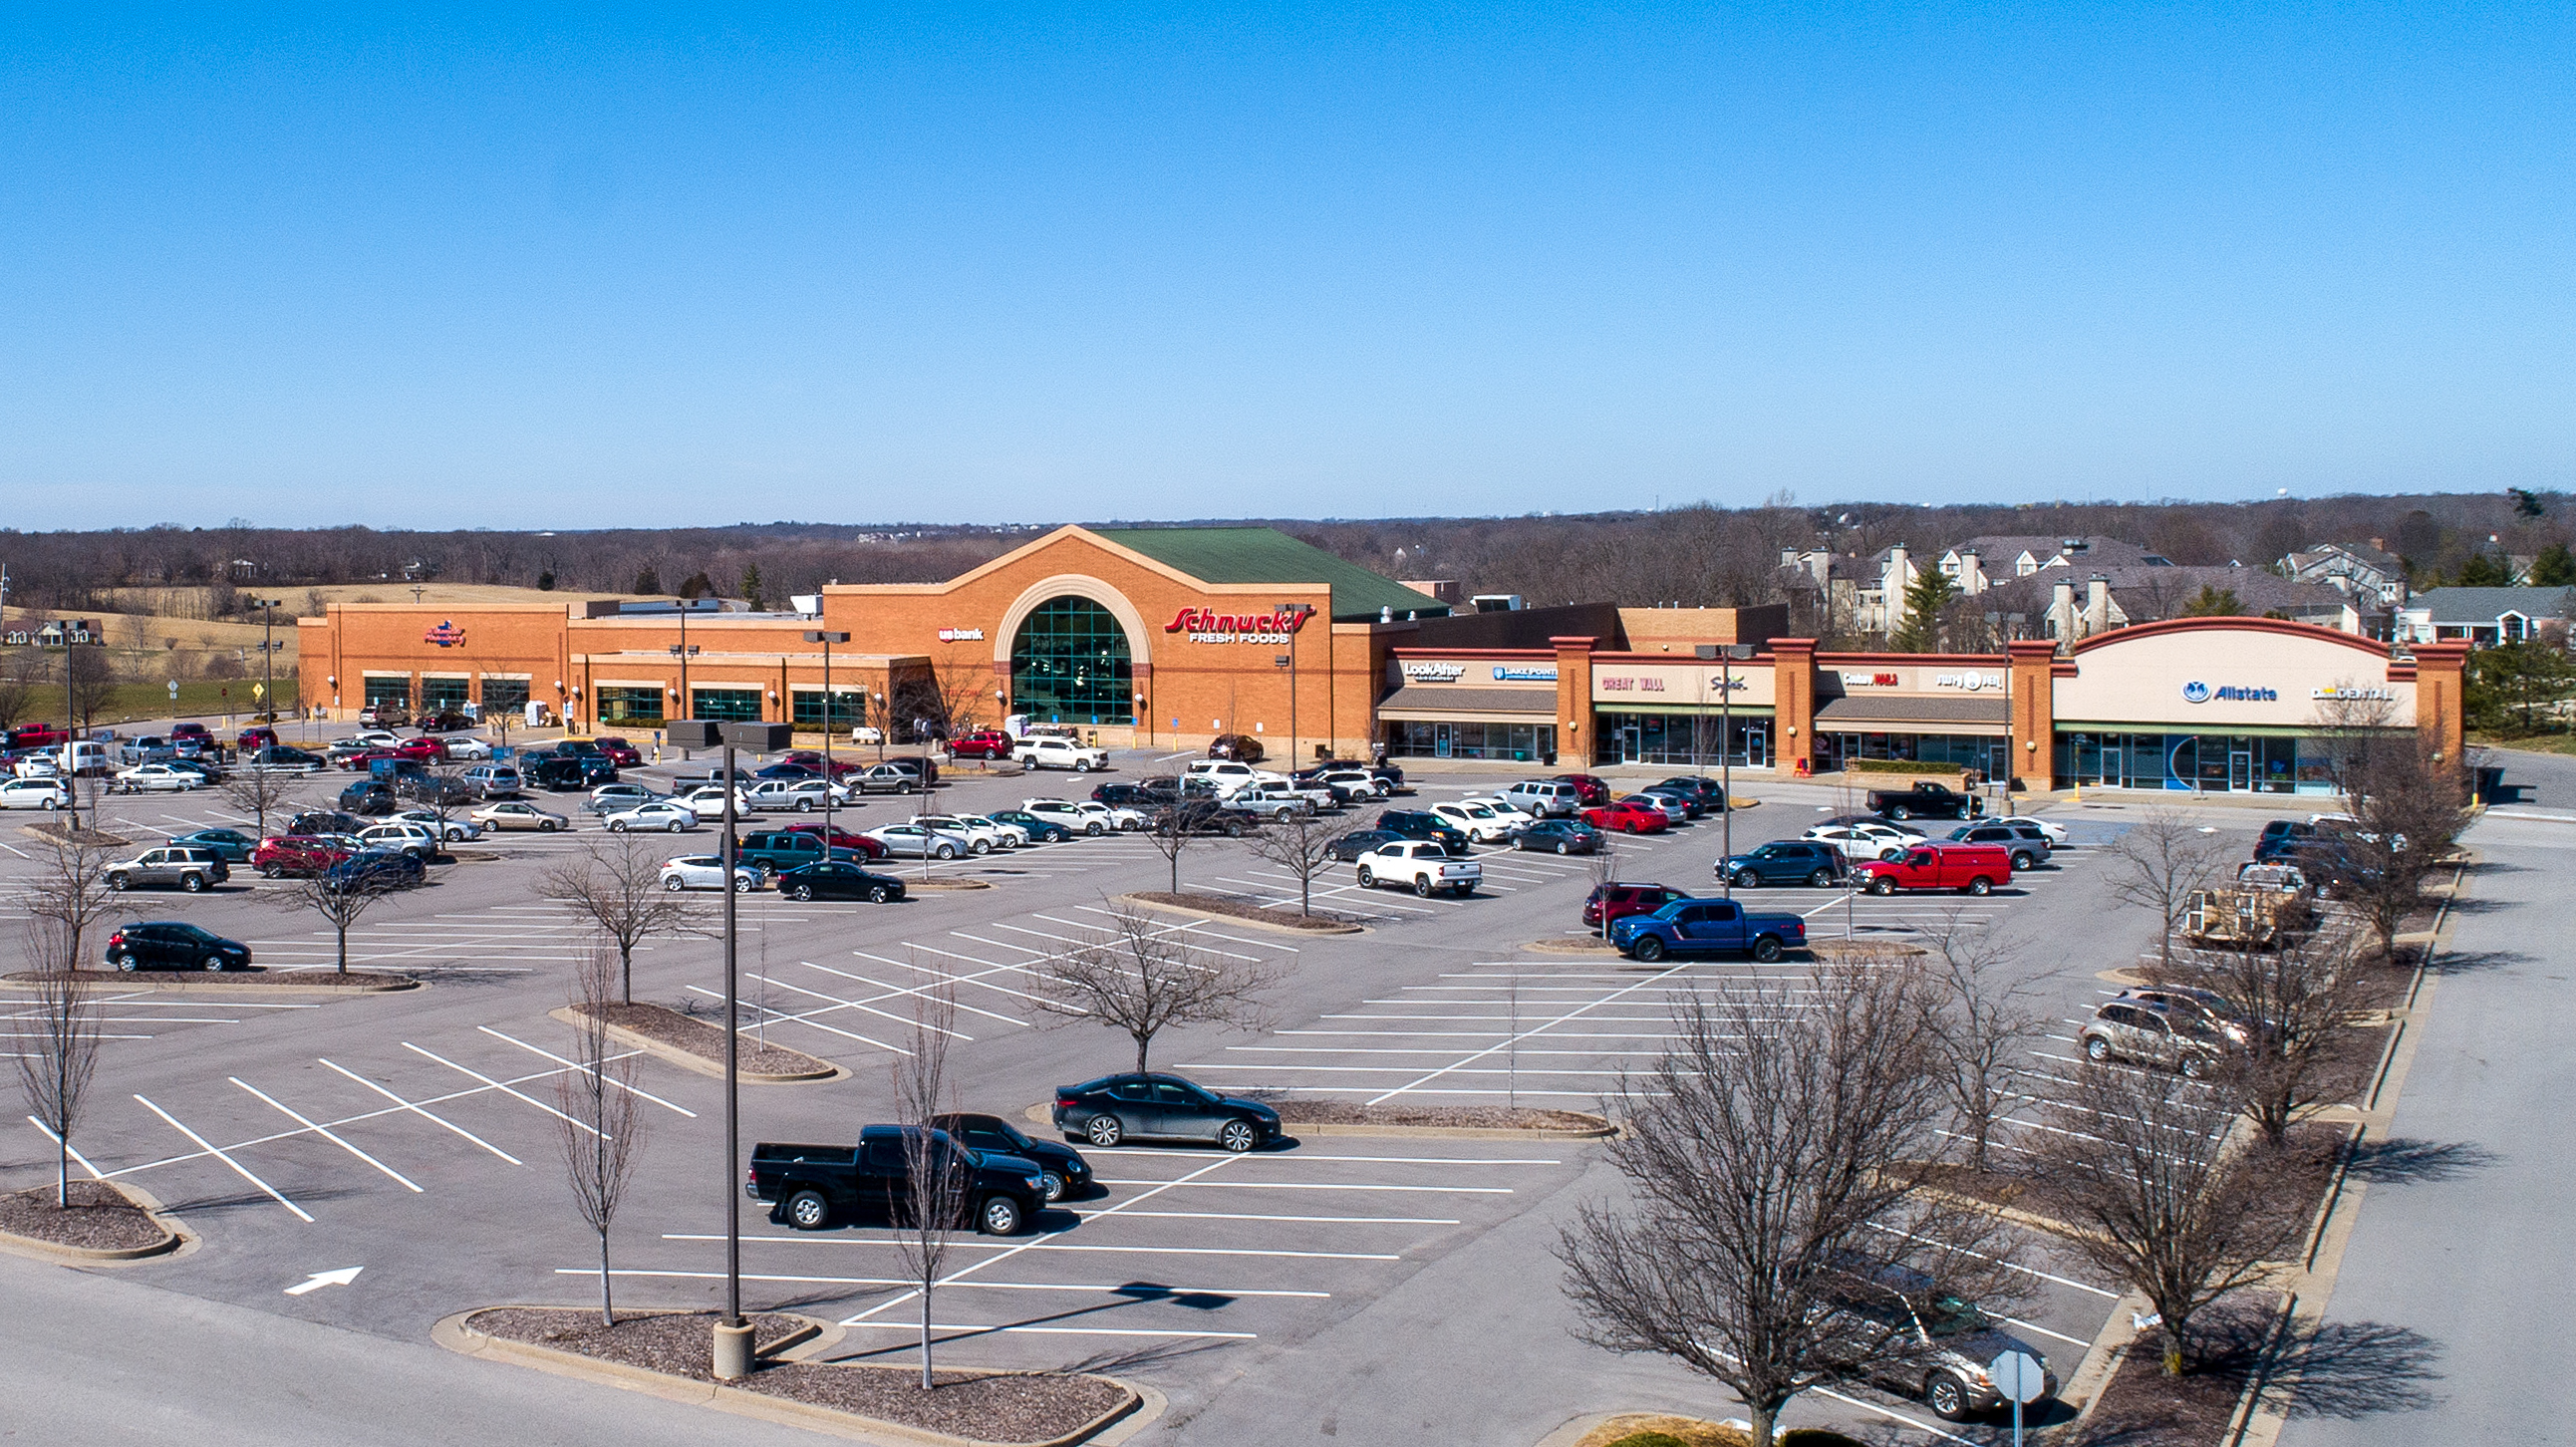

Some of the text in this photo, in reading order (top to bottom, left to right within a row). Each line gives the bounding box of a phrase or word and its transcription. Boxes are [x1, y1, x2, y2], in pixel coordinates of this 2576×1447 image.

[1164, 607, 1316, 633] Schnucks
[1189, 633, 1289, 645] FRESH FOODS
[1602, 678, 1664, 692] GREAT WALL
[2213, 686, 2277, 701] Allstate
